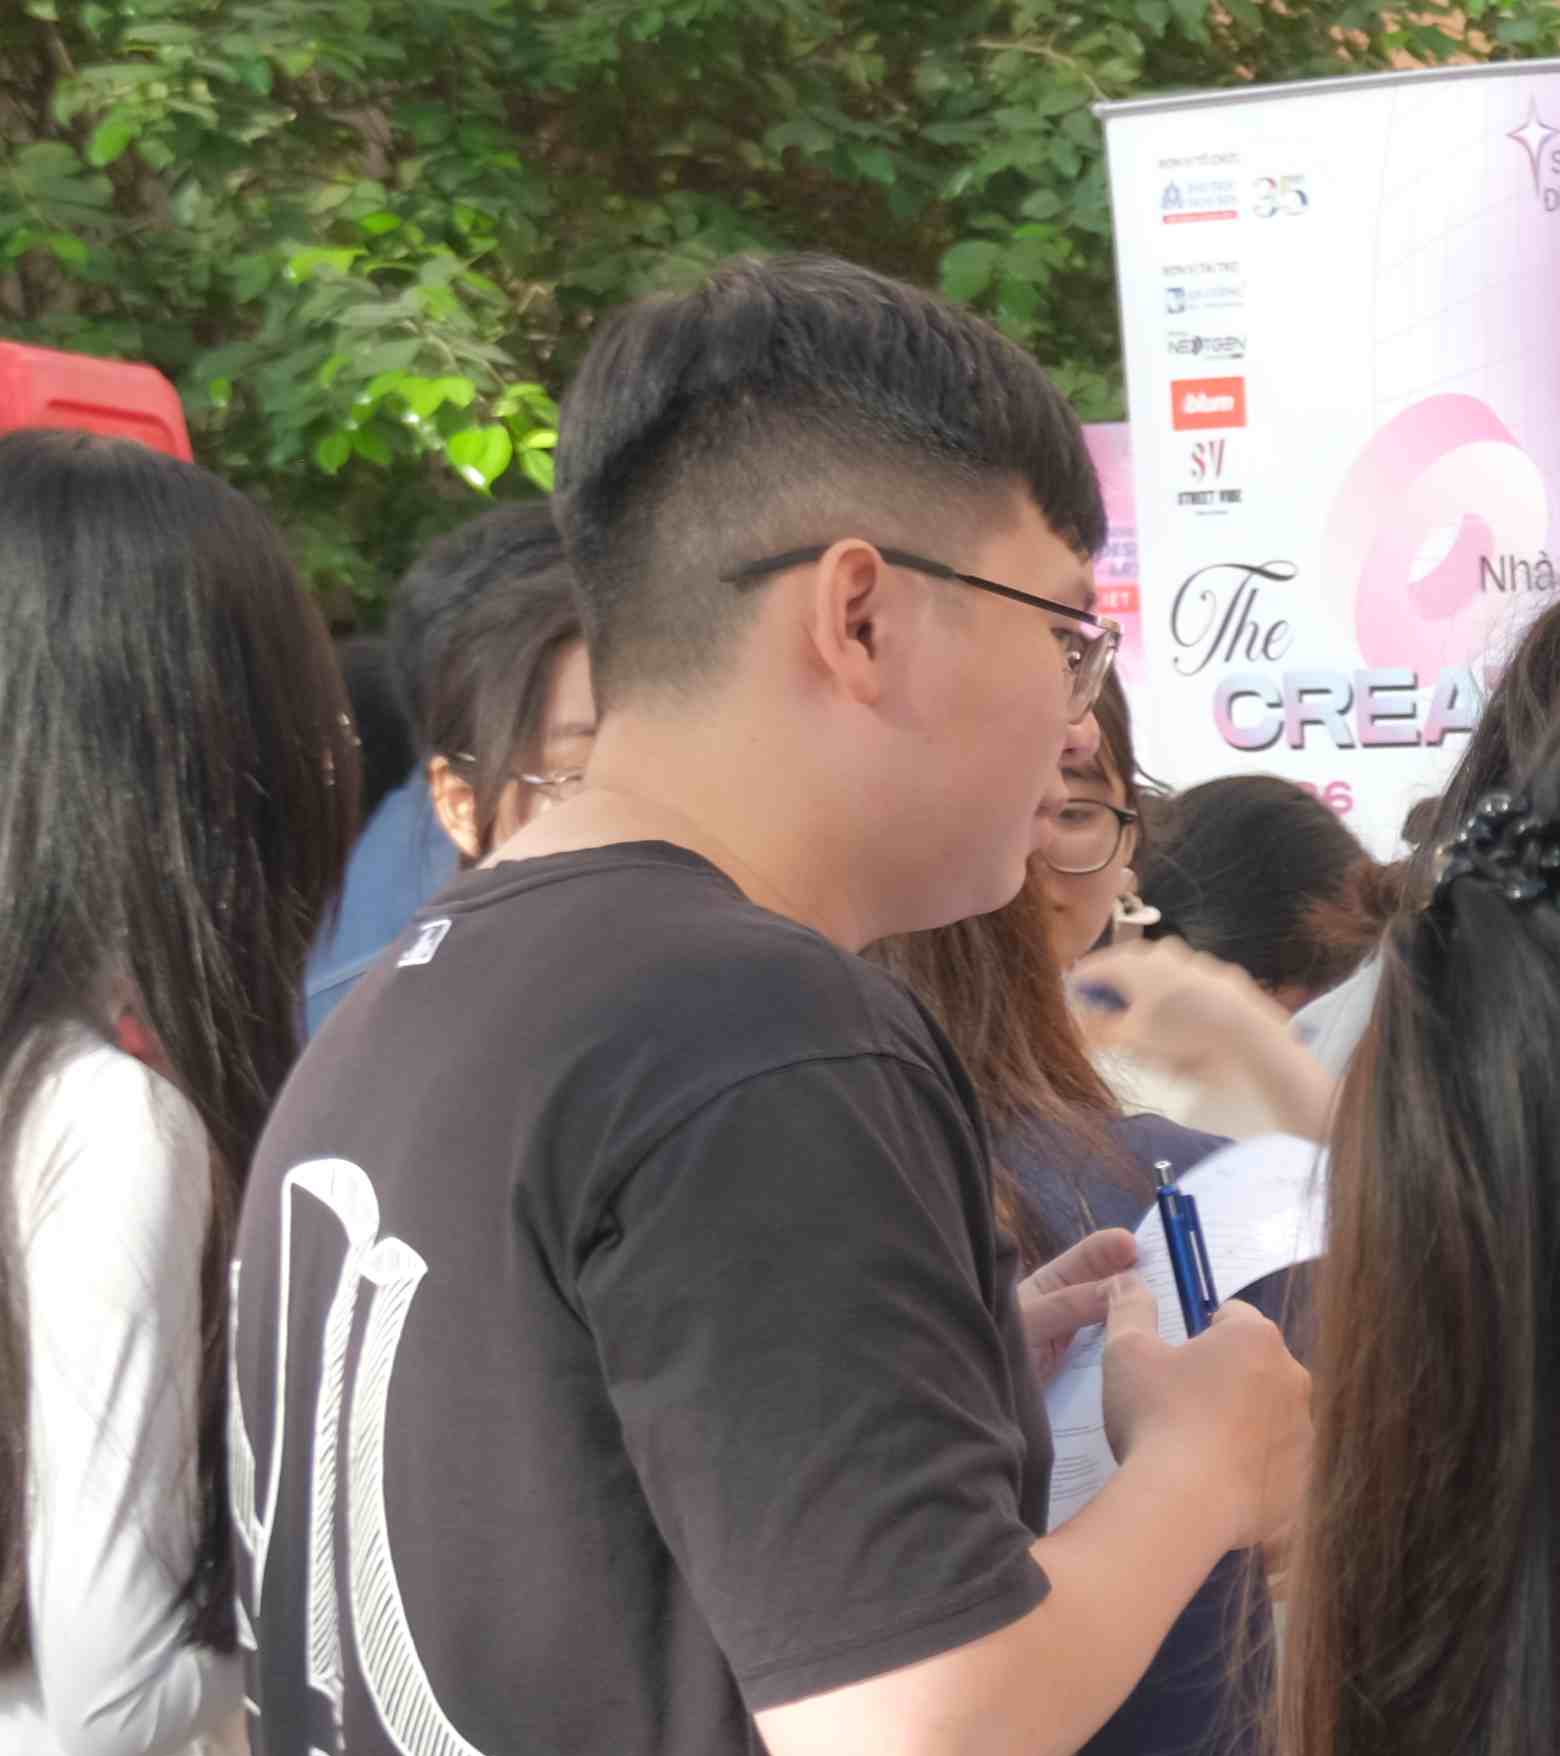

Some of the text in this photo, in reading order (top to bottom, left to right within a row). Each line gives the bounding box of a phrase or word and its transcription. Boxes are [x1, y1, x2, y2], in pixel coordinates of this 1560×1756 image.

[1479, 551, 1556, 593] Nhà
[1168, 560, 1298, 677] The
[1212, 667, 1484, 753] CREA
